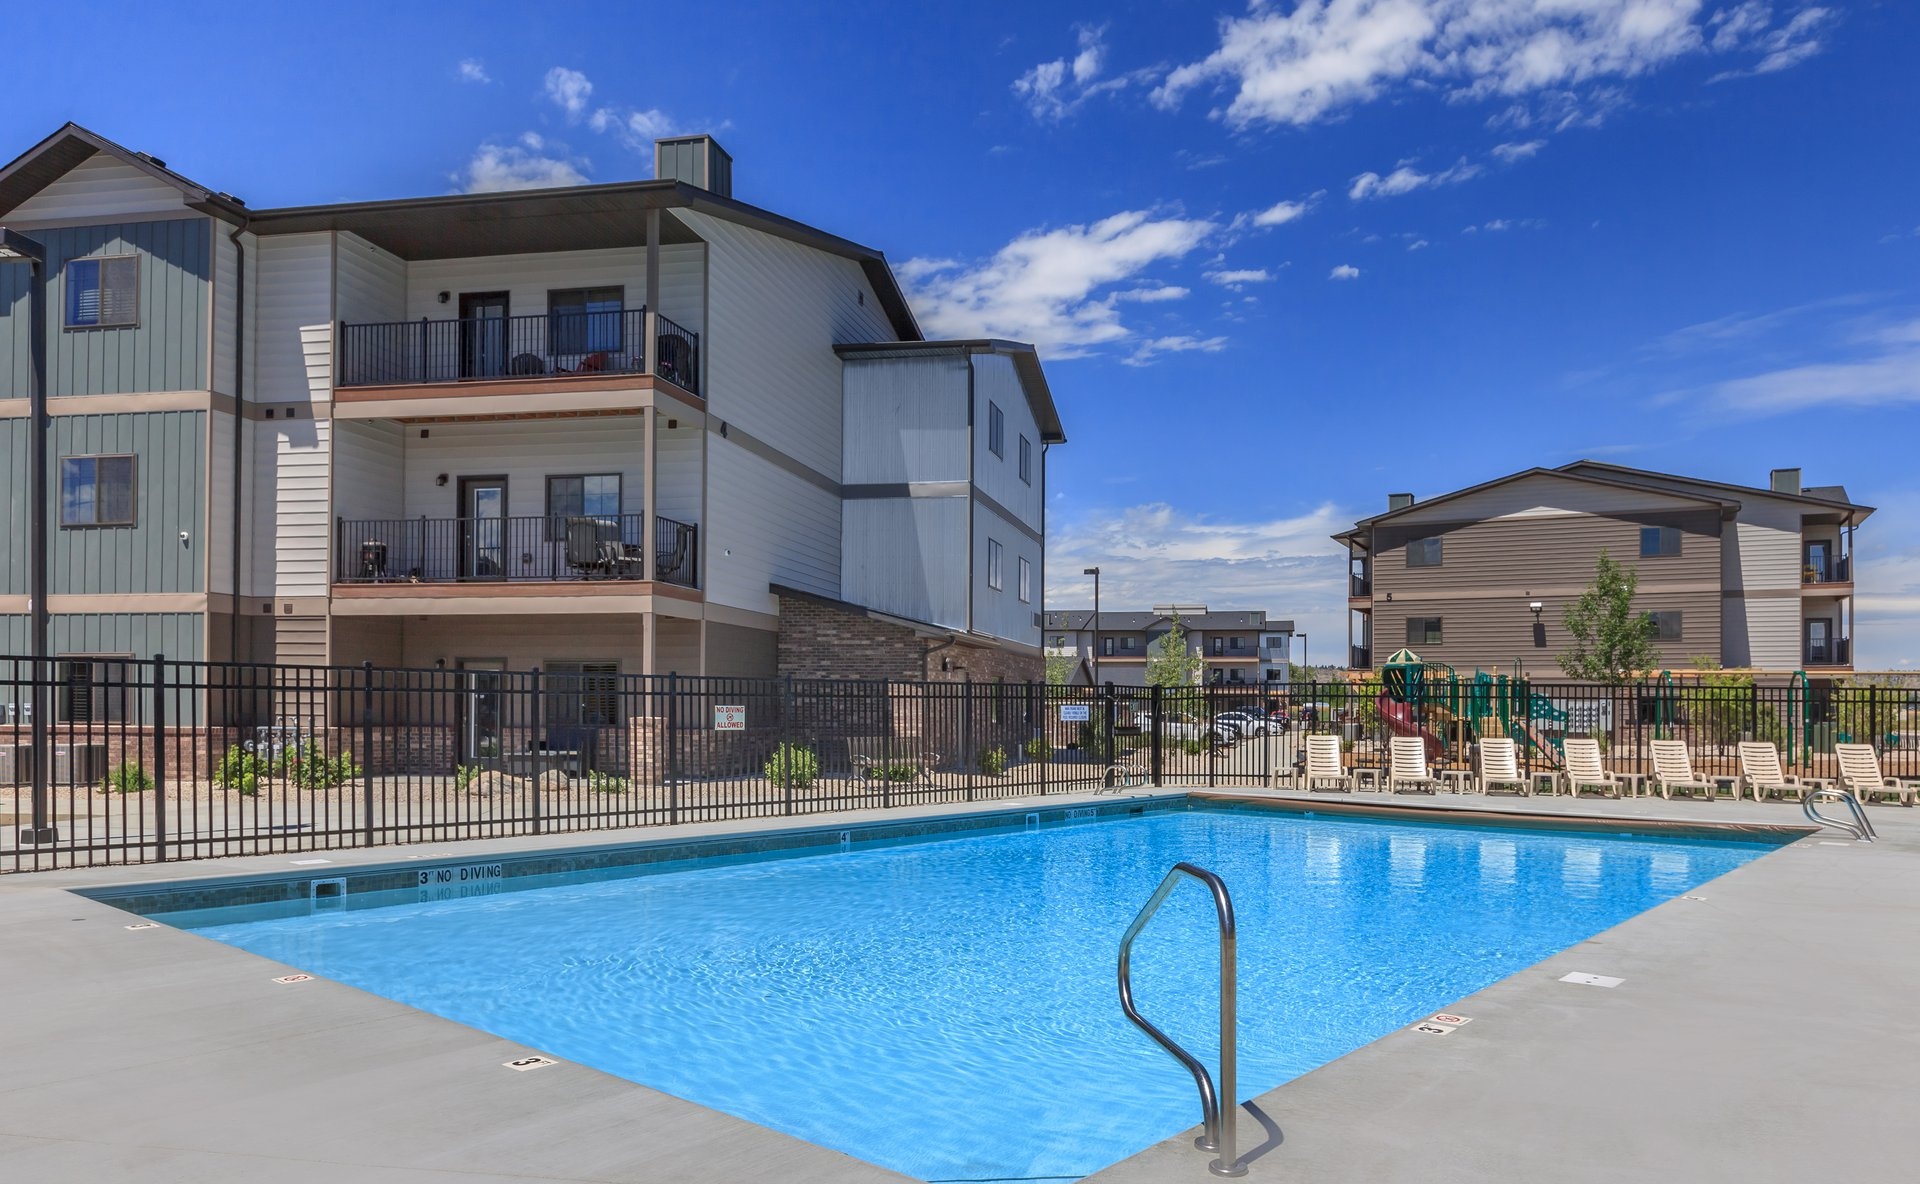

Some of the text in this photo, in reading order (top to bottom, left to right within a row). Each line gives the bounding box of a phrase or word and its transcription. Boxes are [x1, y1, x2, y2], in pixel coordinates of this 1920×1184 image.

[720, 421, 727, 438] 4
[1387, 593, 1392, 602] 5
[437, 869, 452, 883] NO
[460, 865, 501, 881] DIVING
